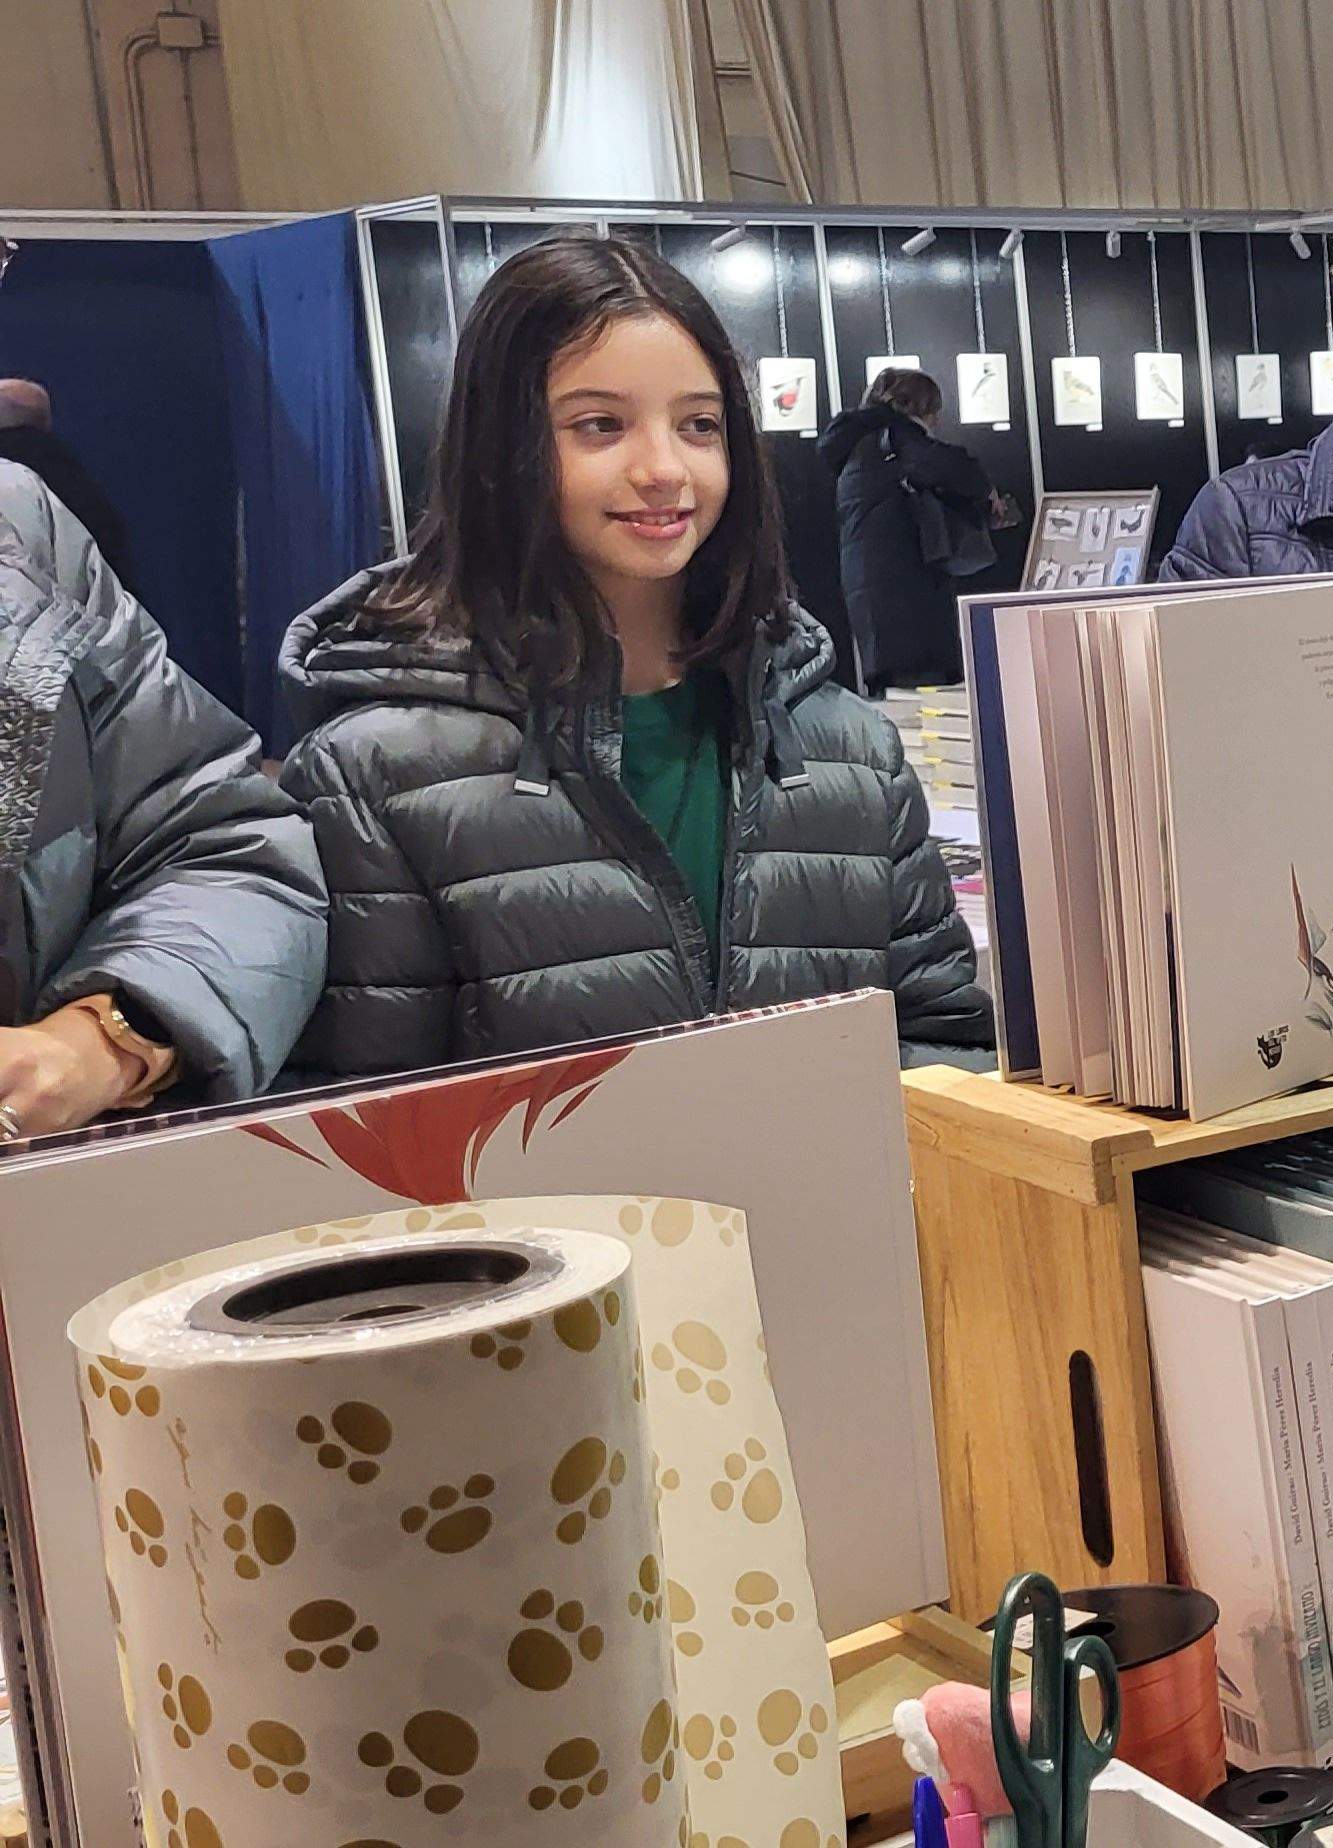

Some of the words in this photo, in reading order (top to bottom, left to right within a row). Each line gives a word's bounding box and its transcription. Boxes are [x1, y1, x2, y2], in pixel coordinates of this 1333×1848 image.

[1273, 1365, 1285, 1408] Heredia
[1306, 1360, 1318, 1402] Heredia
[1279, 1408, 1289, 1438] Pérez
[1311, 1403, 1322, 1432] Pérez
[1288, 1476, 1299, 1514] Guirao
[1320, 1470, 1332, 1506] Guirao
[1293, 1512, 1303, 1545] David
